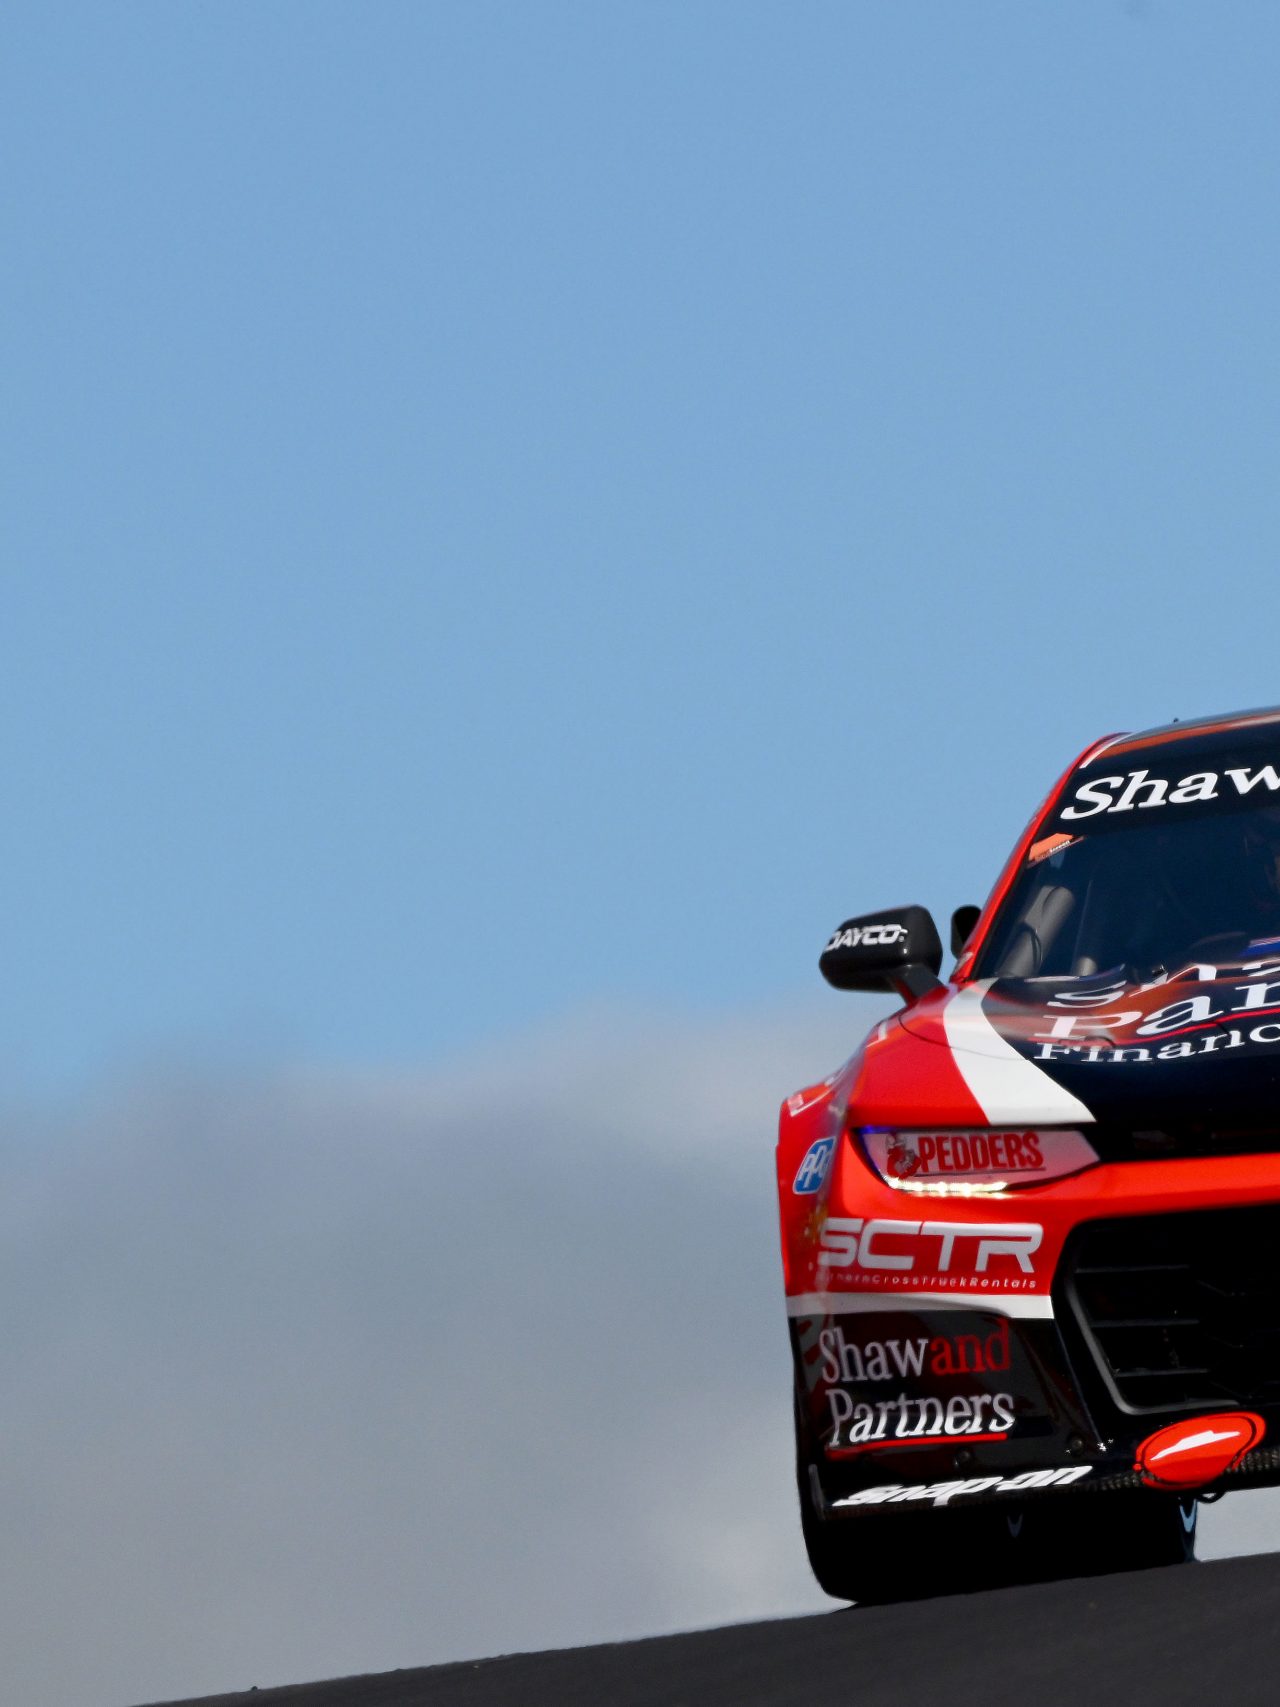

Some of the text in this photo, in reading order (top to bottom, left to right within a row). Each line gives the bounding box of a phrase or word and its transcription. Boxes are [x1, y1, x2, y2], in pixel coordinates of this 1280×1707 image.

[825, 922, 908, 951] DAYCO
[918, 1131, 1044, 1173] PEDDERS
[817, 1217, 1044, 1273] SCTR
[825, 1387, 1017, 1447] Partners
